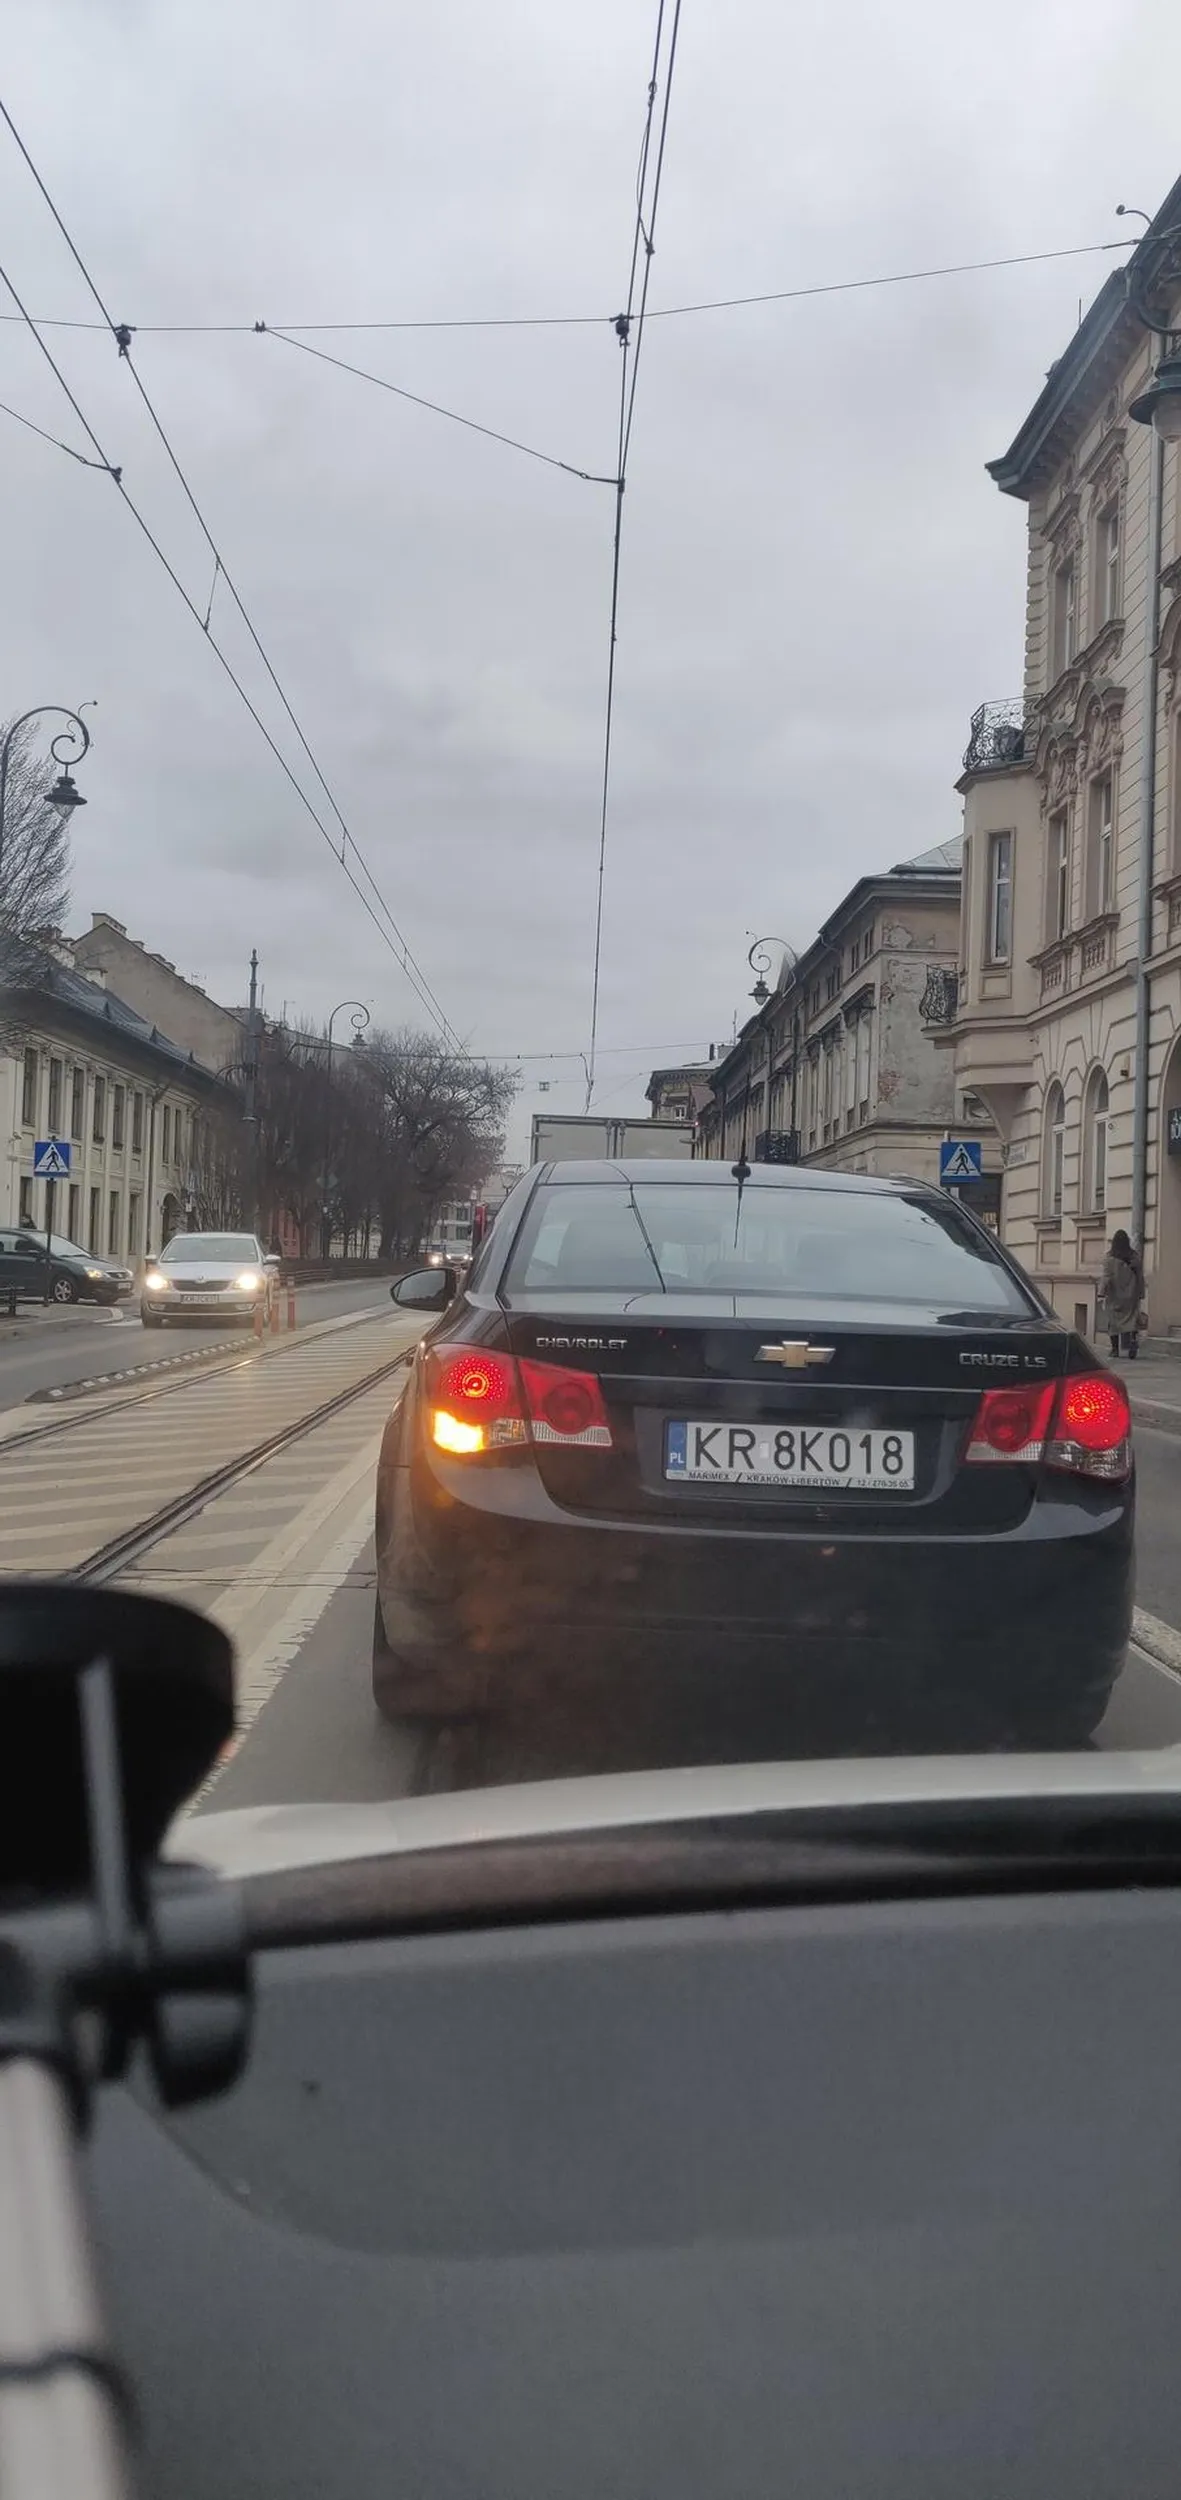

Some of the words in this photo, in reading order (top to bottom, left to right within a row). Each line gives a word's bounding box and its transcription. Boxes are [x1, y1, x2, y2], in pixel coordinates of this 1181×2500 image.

[536, 1337, 628, 1349] CHEVROLET
[959, 1352, 1019, 1367] CRUZE
[1024, 1355, 1047, 1368] LS
[670, 1451, 685, 1464] PL
[695, 1426, 756, 1470] KR
[774, 1430, 904, 1475] 8K018
